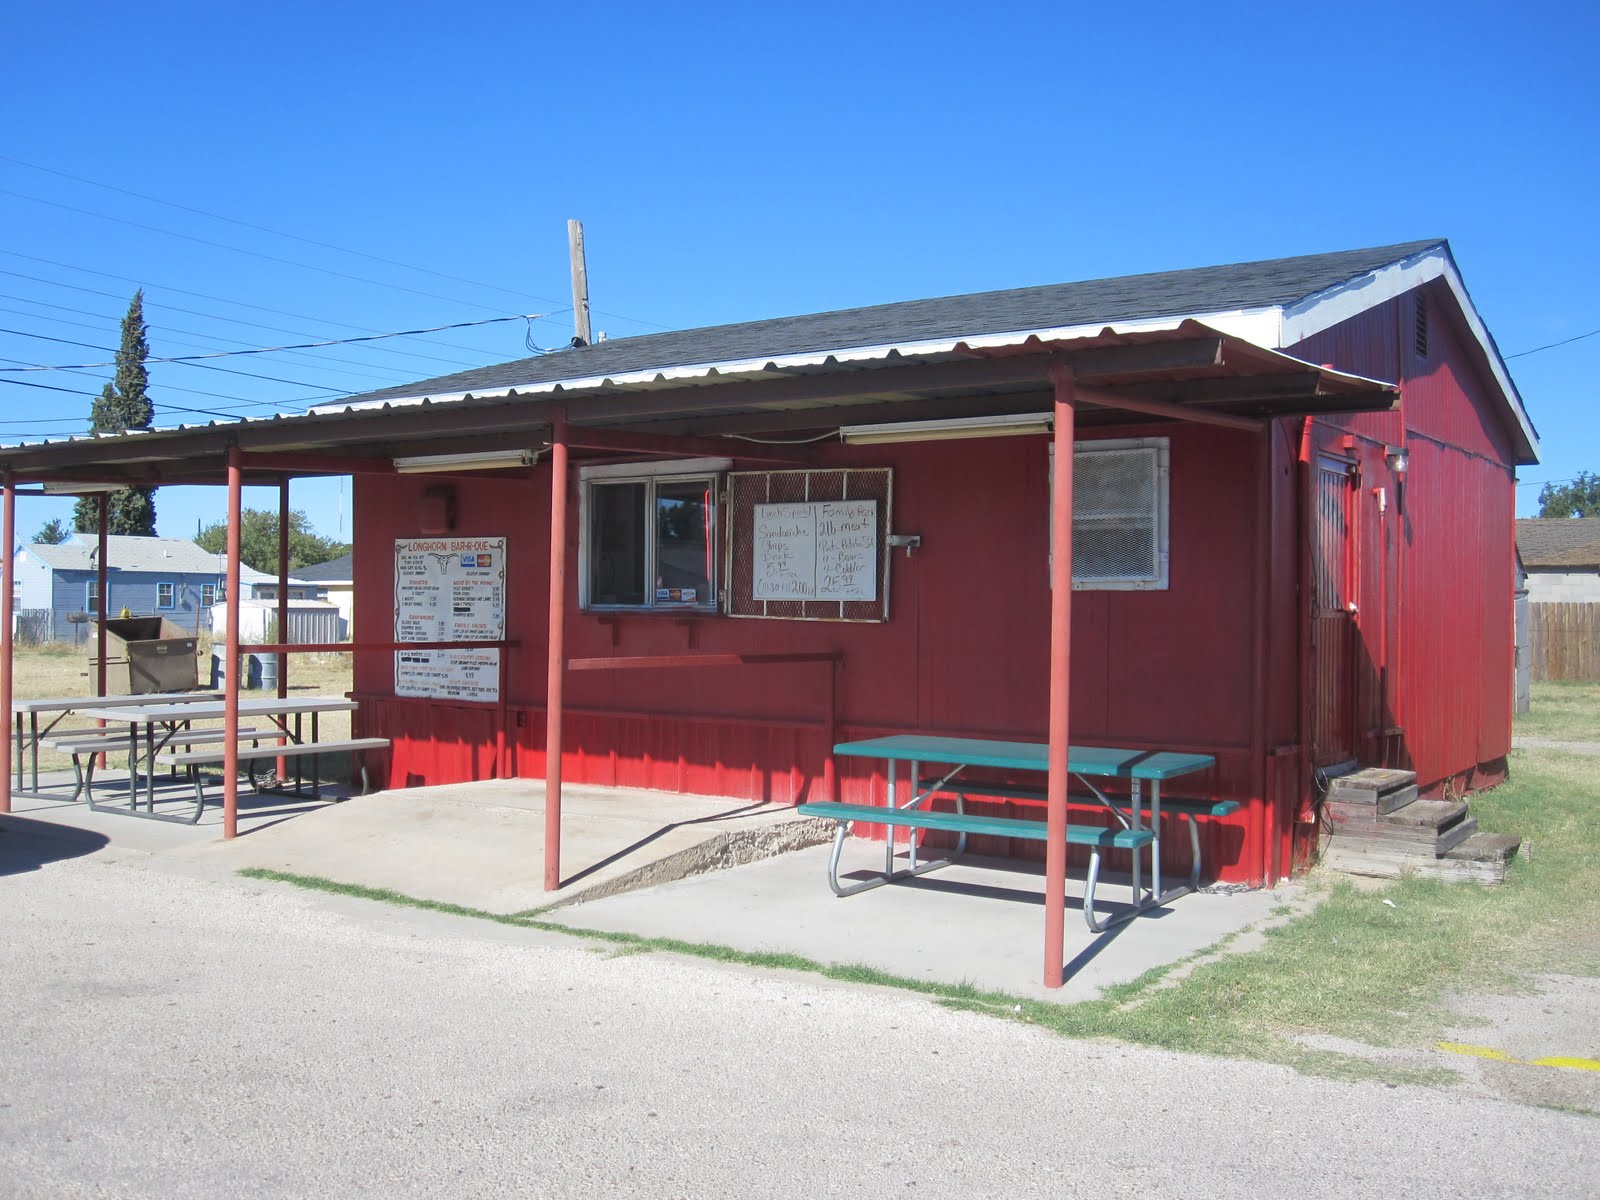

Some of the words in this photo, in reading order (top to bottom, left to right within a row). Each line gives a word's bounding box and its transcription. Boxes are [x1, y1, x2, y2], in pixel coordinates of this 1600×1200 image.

[822, 504, 855, 519] Family
[408, 541, 447, 552] LONGHORN
[450, 541, 489, 552] BAR-B-QUE
